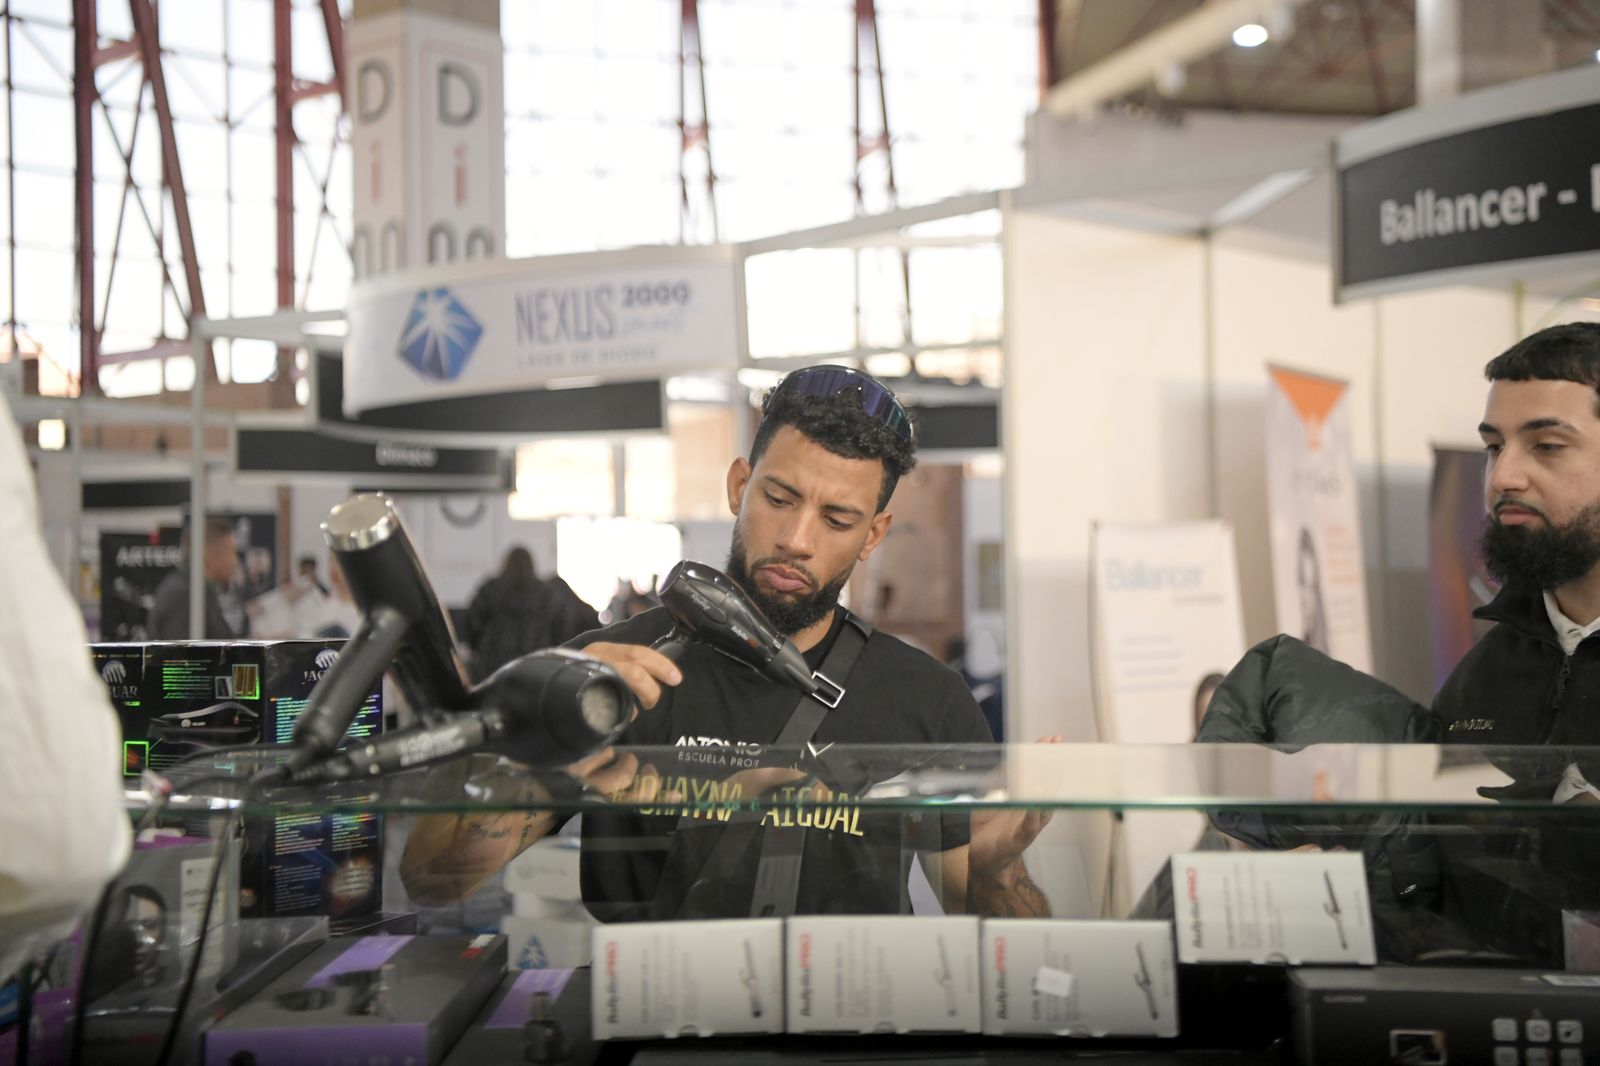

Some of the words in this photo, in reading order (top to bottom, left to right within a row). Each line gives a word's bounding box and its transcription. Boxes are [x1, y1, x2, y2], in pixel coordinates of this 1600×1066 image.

[1380, 182, 1548, 246] Ballancer
[514, 284, 616, 346] NEXUS
[621, 279, 692, 308] 2000
[677, 750, 727, 765] ESCUELA
